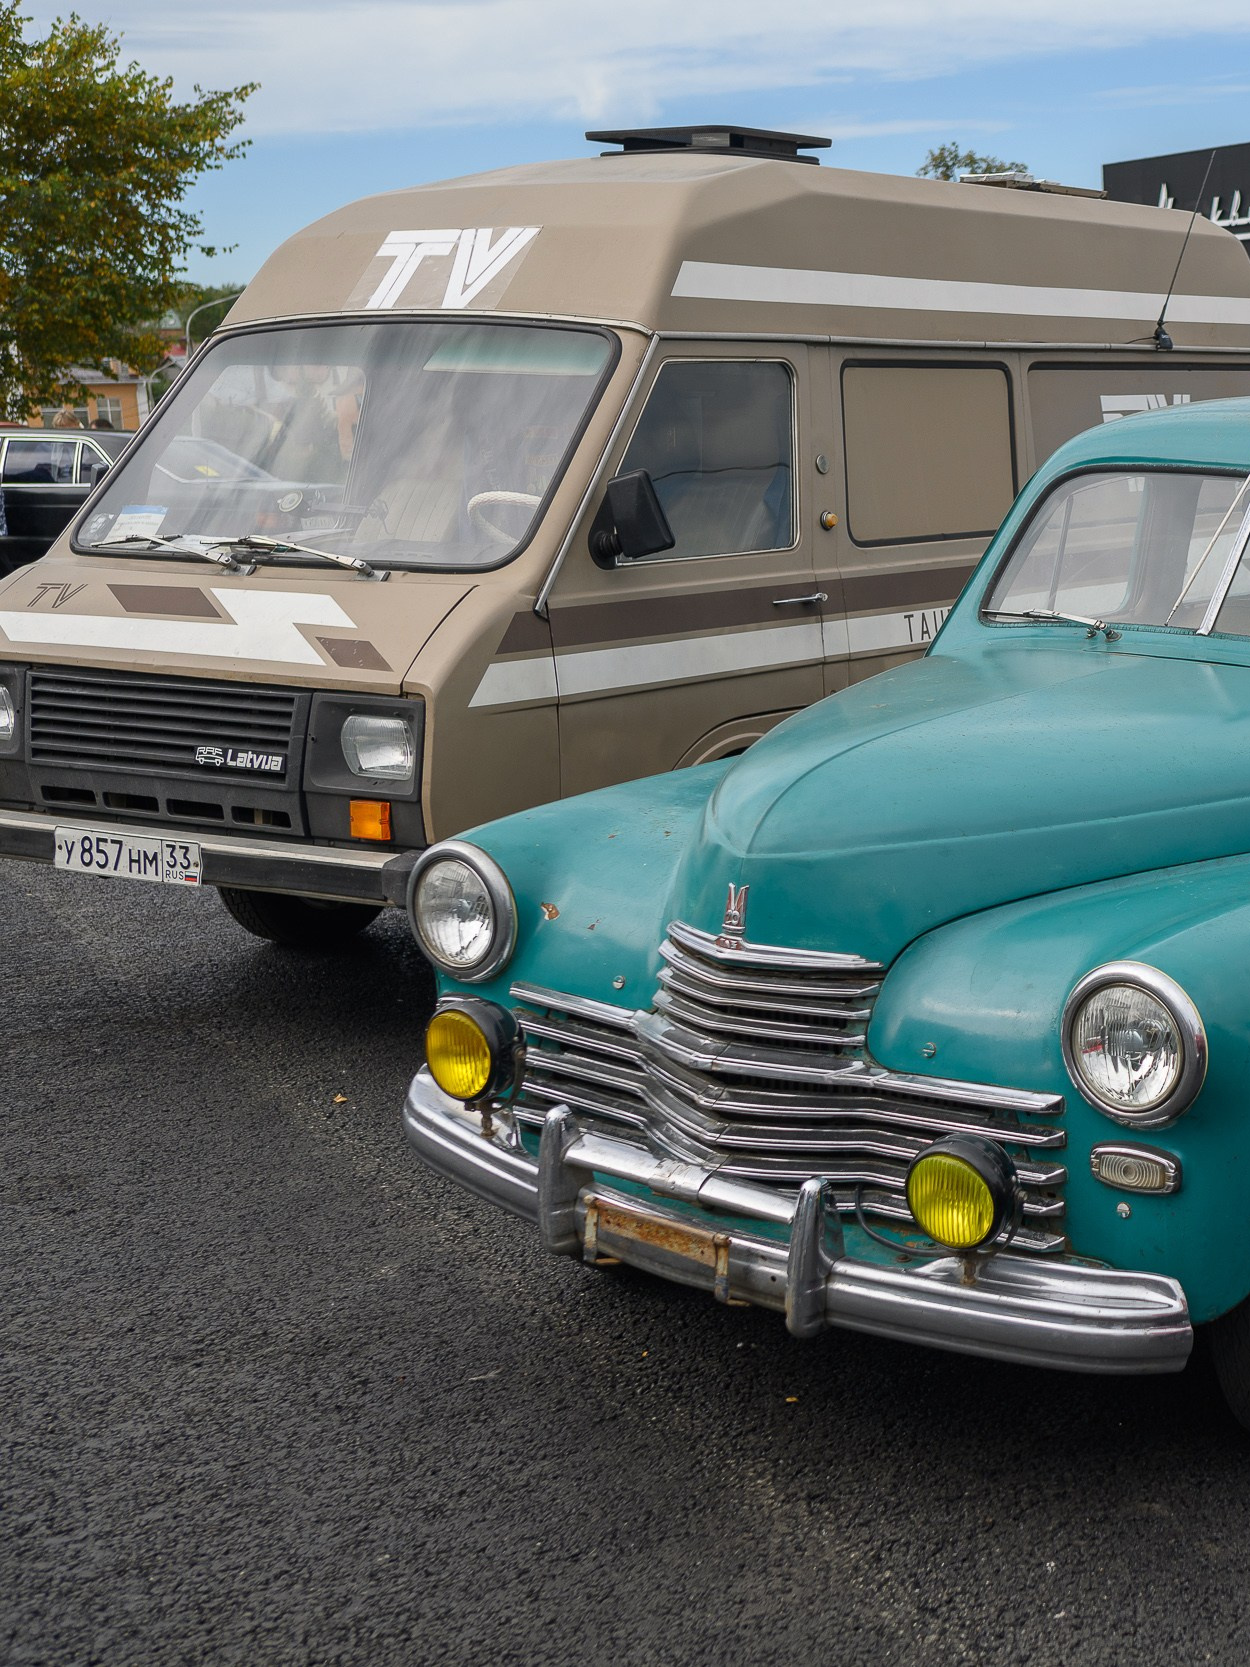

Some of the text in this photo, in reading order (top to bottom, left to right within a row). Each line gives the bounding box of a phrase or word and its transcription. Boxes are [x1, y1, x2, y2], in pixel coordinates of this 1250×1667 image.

[364, 227, 542, 309] TV
[27, 583, 89, 609] TV
[226, 748, 283, 771] Latvija
[165, 843, 191, 870] 33
[165, 869, 185, 881] RUS
